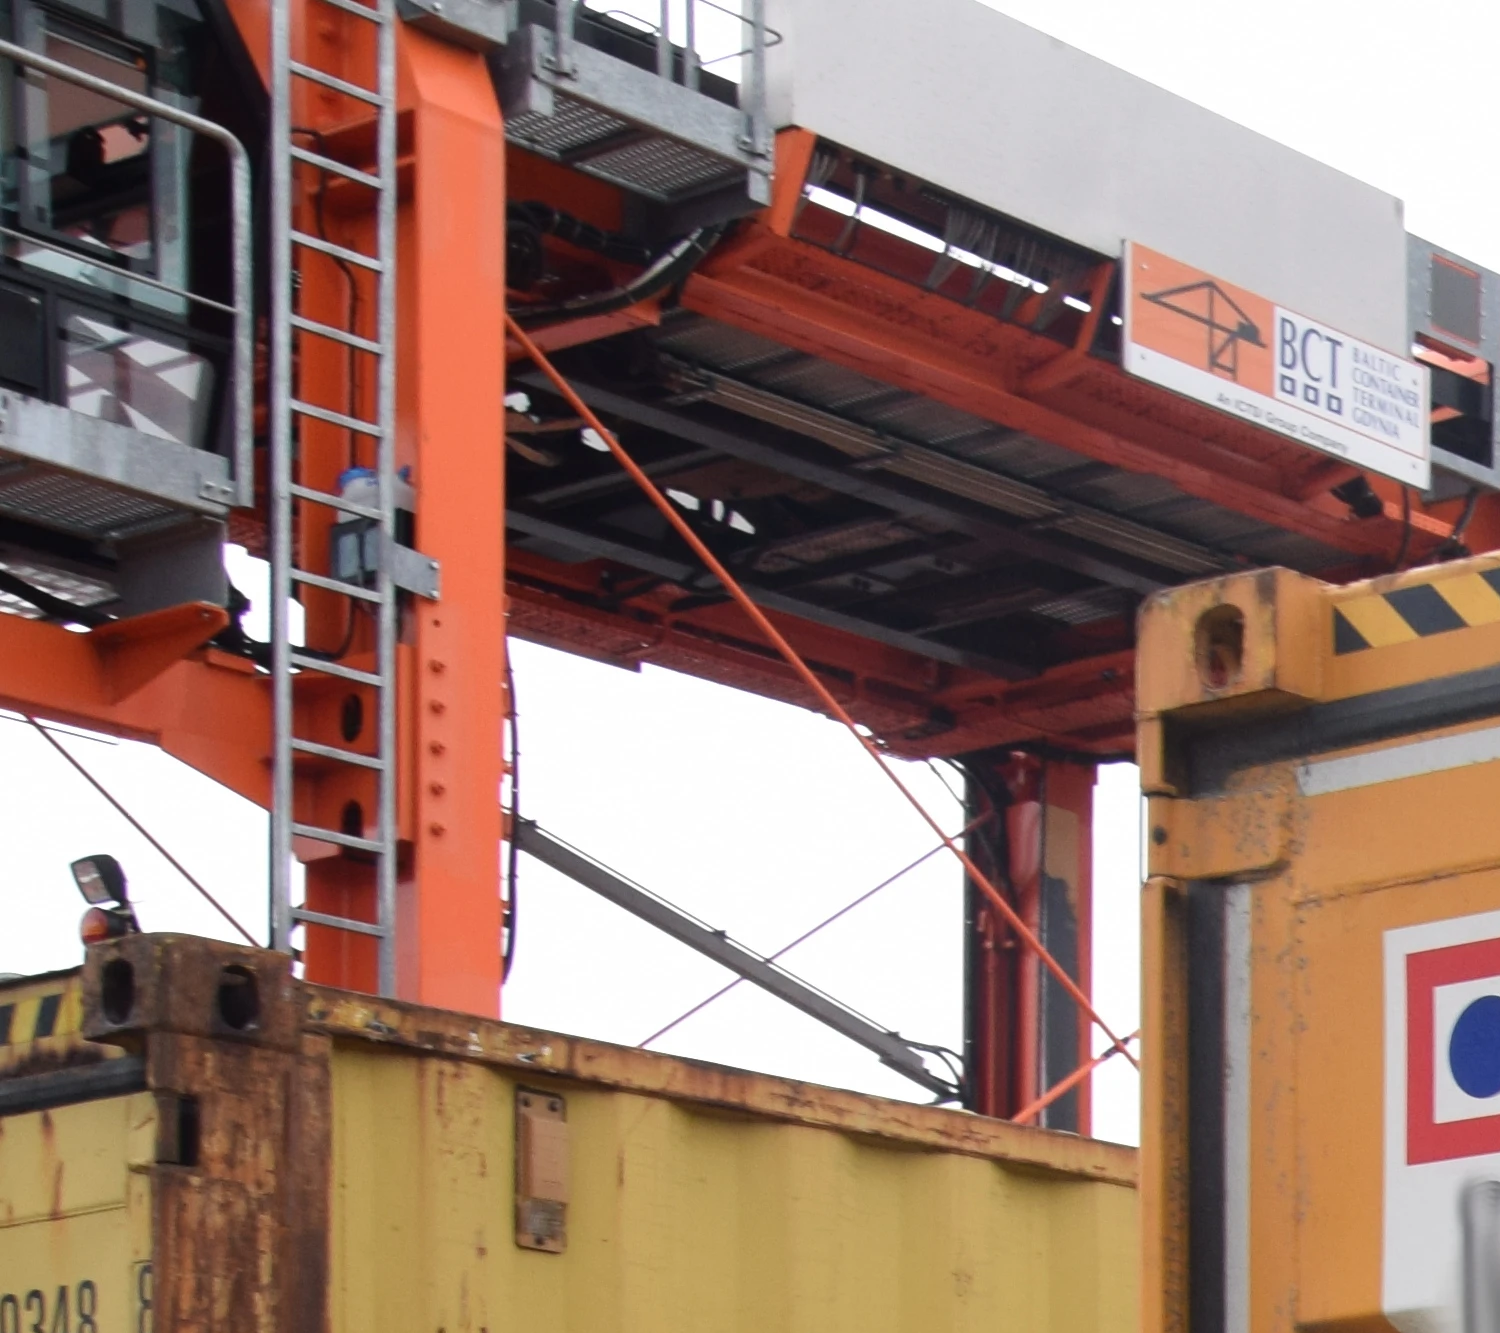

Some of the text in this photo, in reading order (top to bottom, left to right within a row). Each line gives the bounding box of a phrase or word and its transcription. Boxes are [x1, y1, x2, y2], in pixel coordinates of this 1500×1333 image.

[1280, 316, 1343, 389] BCT
[1353, 346, 1401, 382] BALTIC
[1353, 367, 1419, 409] CONTAINER
[1353, 386, 1420, 429] TERMINAL
[1353, 406, 1400, 440] GDYNIA
